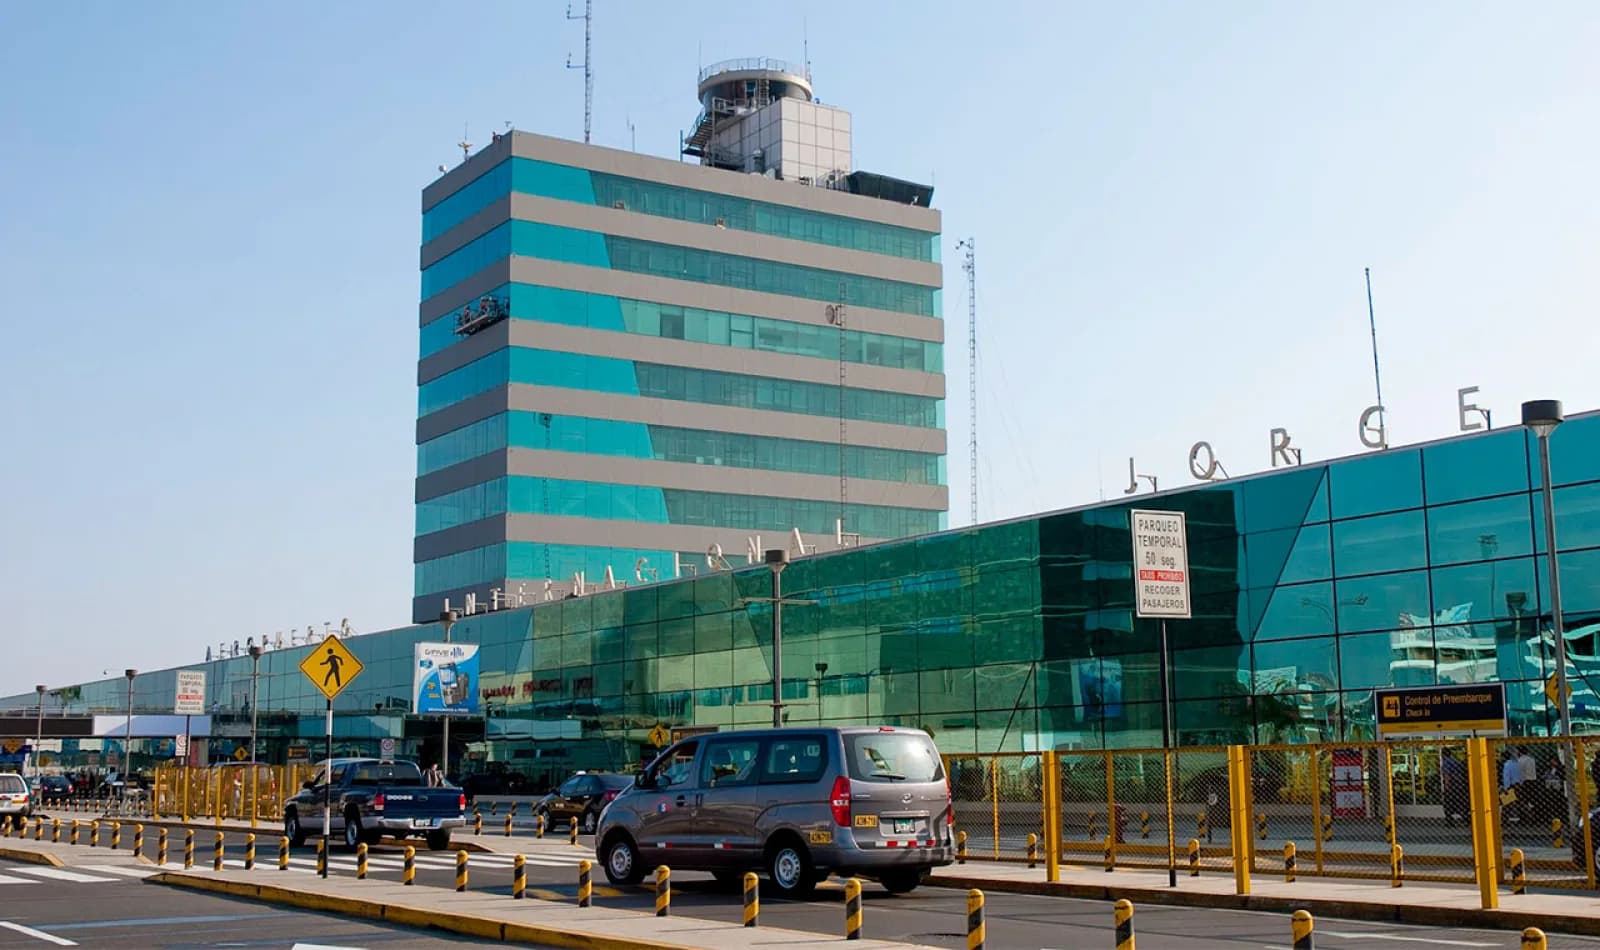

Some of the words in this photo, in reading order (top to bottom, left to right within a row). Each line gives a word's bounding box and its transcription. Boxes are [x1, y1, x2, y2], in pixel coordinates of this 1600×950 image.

[1124, 386, 1482, 495] JORGE
[1139, 520, 1178, 532] PARQUEO
[1137, 535, 1182, 548] TEMPORAL
[1145, 551, 1156, 566] 50
[1144, 585, 1180, 596] RECOGER
[1142, 599, 1185, 609] PASAJEROS
[1405, 696, 1430, 706] Control
[1432, 695, 1441, 704] de
[1443, 694, 1492, 704] Preembarque
[1406, 709, 1422, 717] Check
